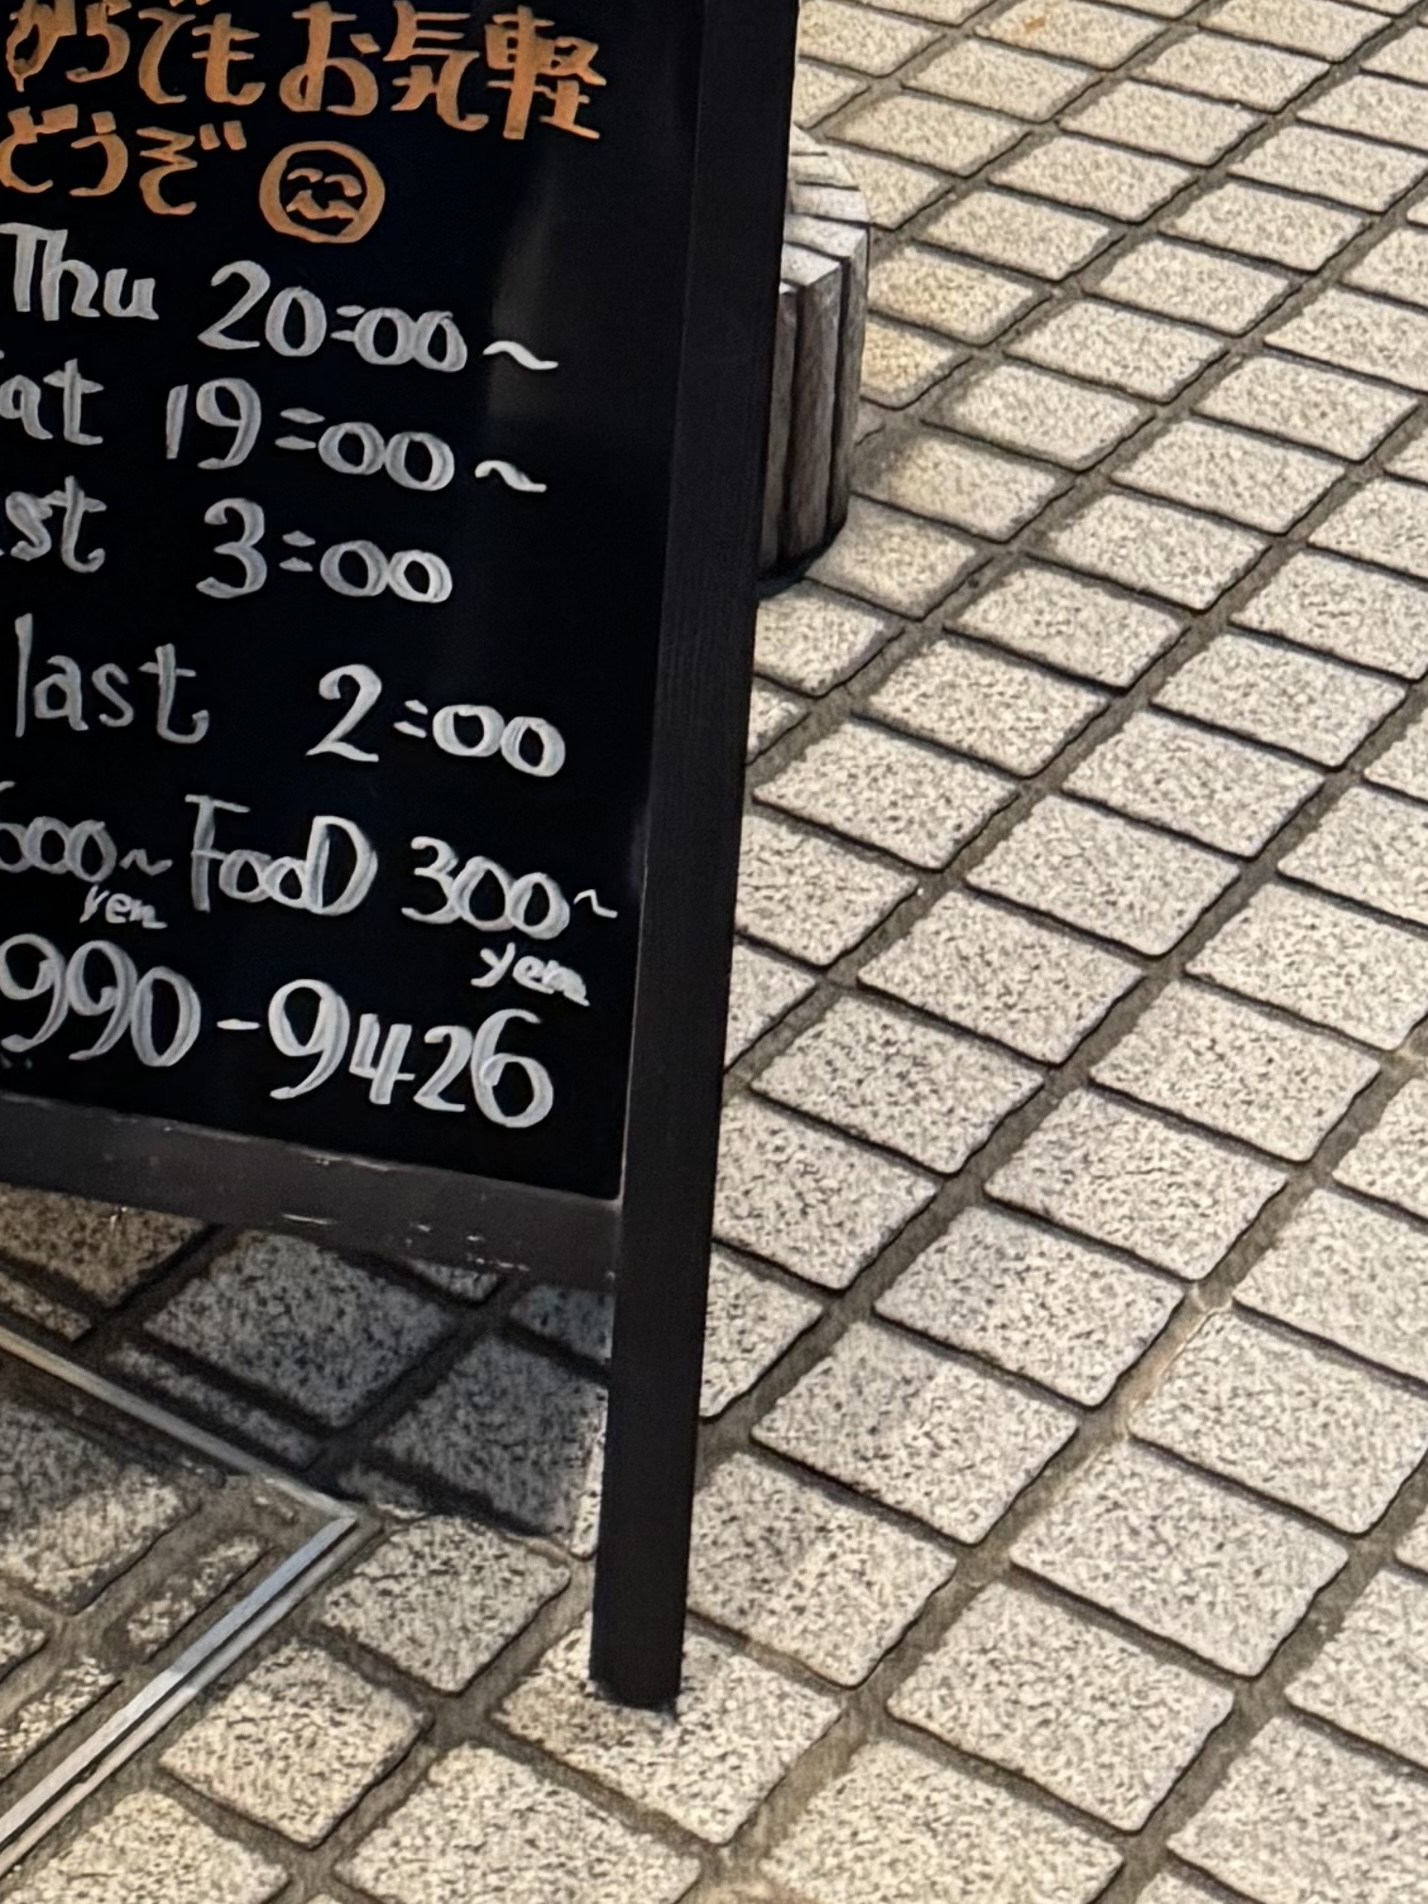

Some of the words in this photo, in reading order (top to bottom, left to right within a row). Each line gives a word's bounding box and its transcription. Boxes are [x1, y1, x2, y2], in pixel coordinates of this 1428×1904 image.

[196, 496, 452, 604] 3:00
[15, 613, 209, 744] last
[306, 664, 566, 778] 2:00
